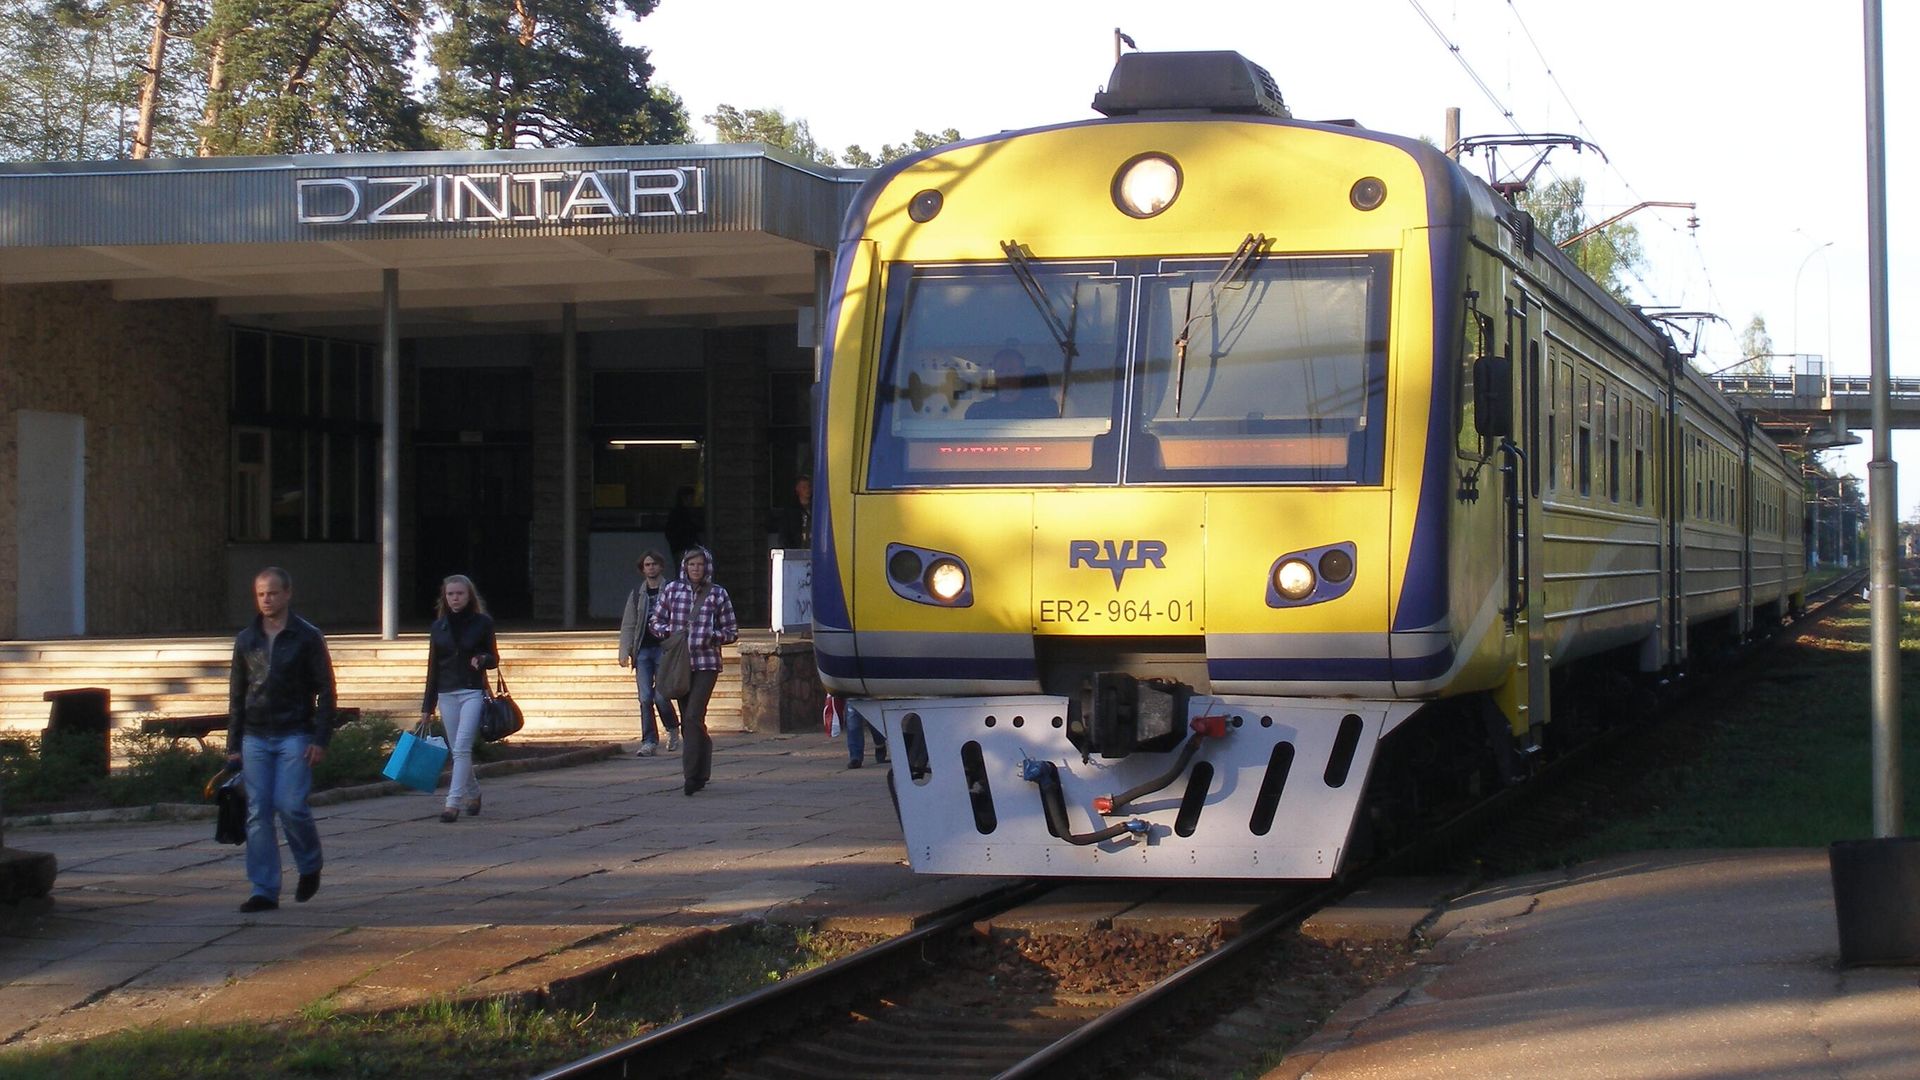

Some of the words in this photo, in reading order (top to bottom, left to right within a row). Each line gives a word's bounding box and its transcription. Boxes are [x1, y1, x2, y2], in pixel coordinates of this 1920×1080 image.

[296, 166, 706, 224] DZINTARI
[1069, 540, 1167, 592] RVR
[1040, 599, 1194, 622] ER2-964-01
